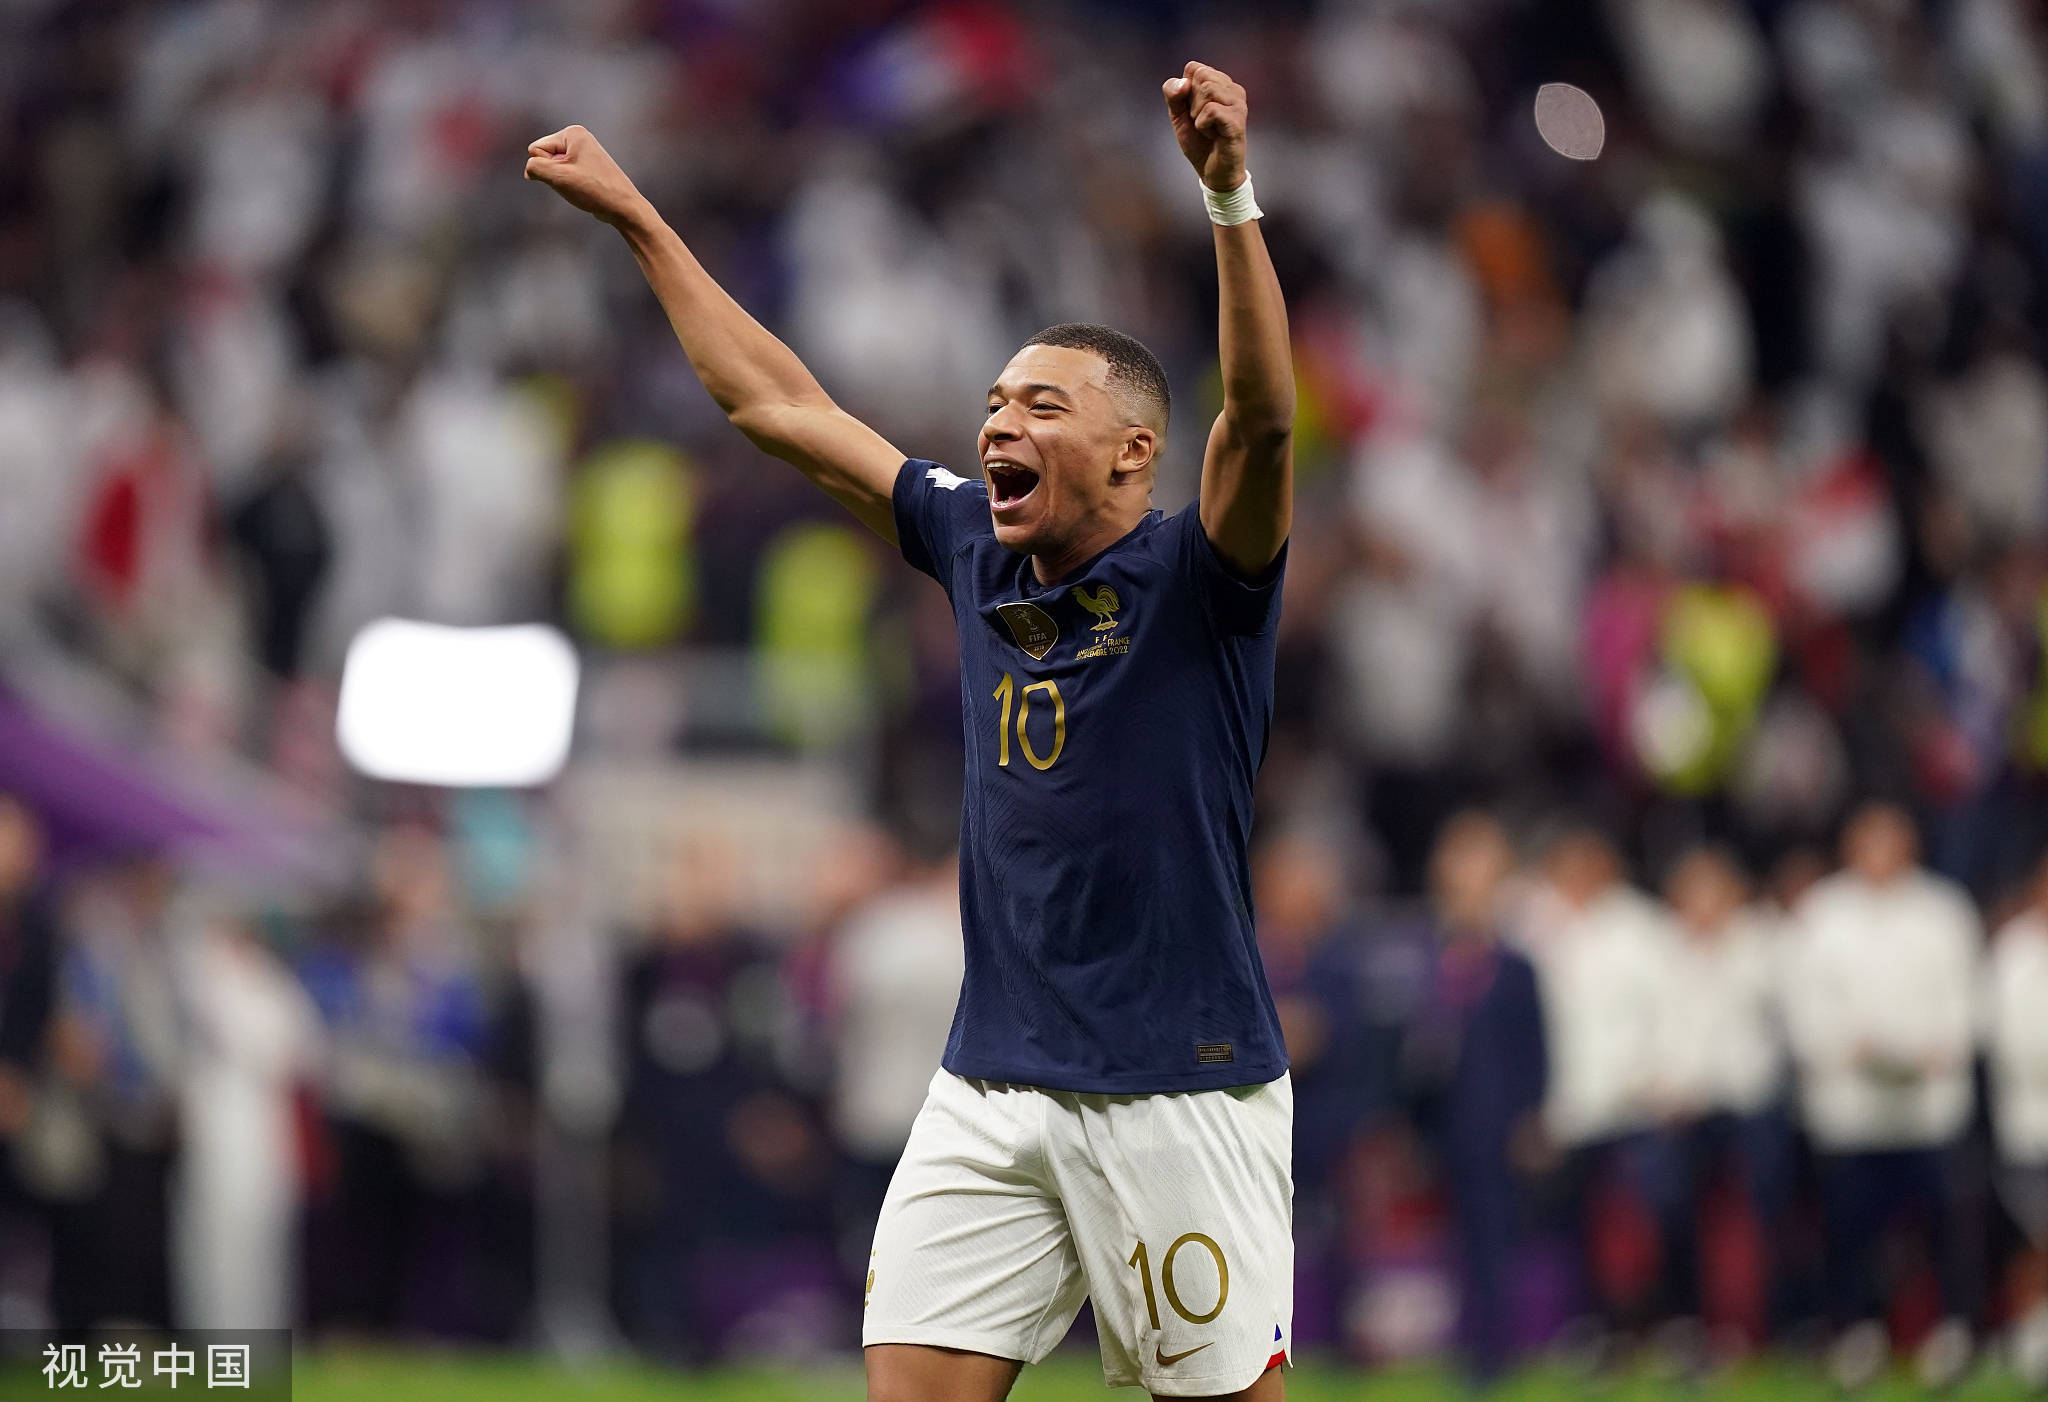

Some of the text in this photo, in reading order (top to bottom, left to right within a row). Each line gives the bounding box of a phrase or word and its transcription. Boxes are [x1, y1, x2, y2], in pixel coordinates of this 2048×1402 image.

[1028, 632, 1047, 643] FIFA
[1107, 636, 1130, 647] FRANCE
[1109, 645, 1128, 655] 2022
[993, 672, 1066, 770] 10
[1128, 1232, 1229, 1330] 10
